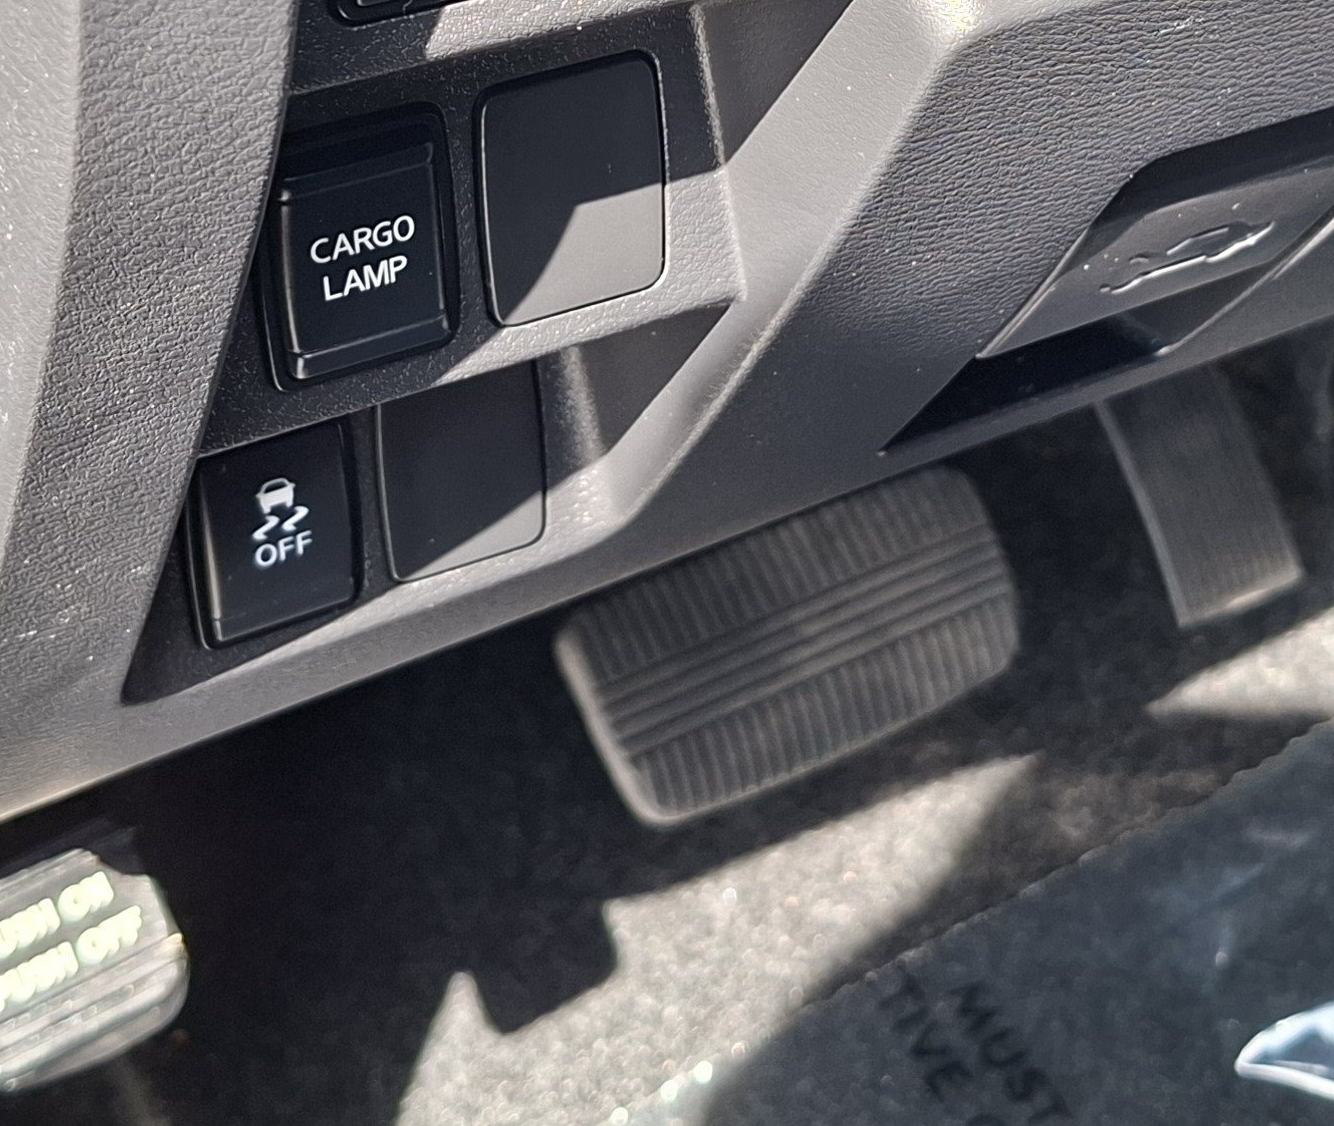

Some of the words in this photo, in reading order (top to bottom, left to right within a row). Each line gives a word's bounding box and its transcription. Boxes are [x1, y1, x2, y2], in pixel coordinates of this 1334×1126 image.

[310, 215, 416, 264] CARGO
[322, 254, 409, 302] LAMP
[254, 528, 314, 568] OFF
